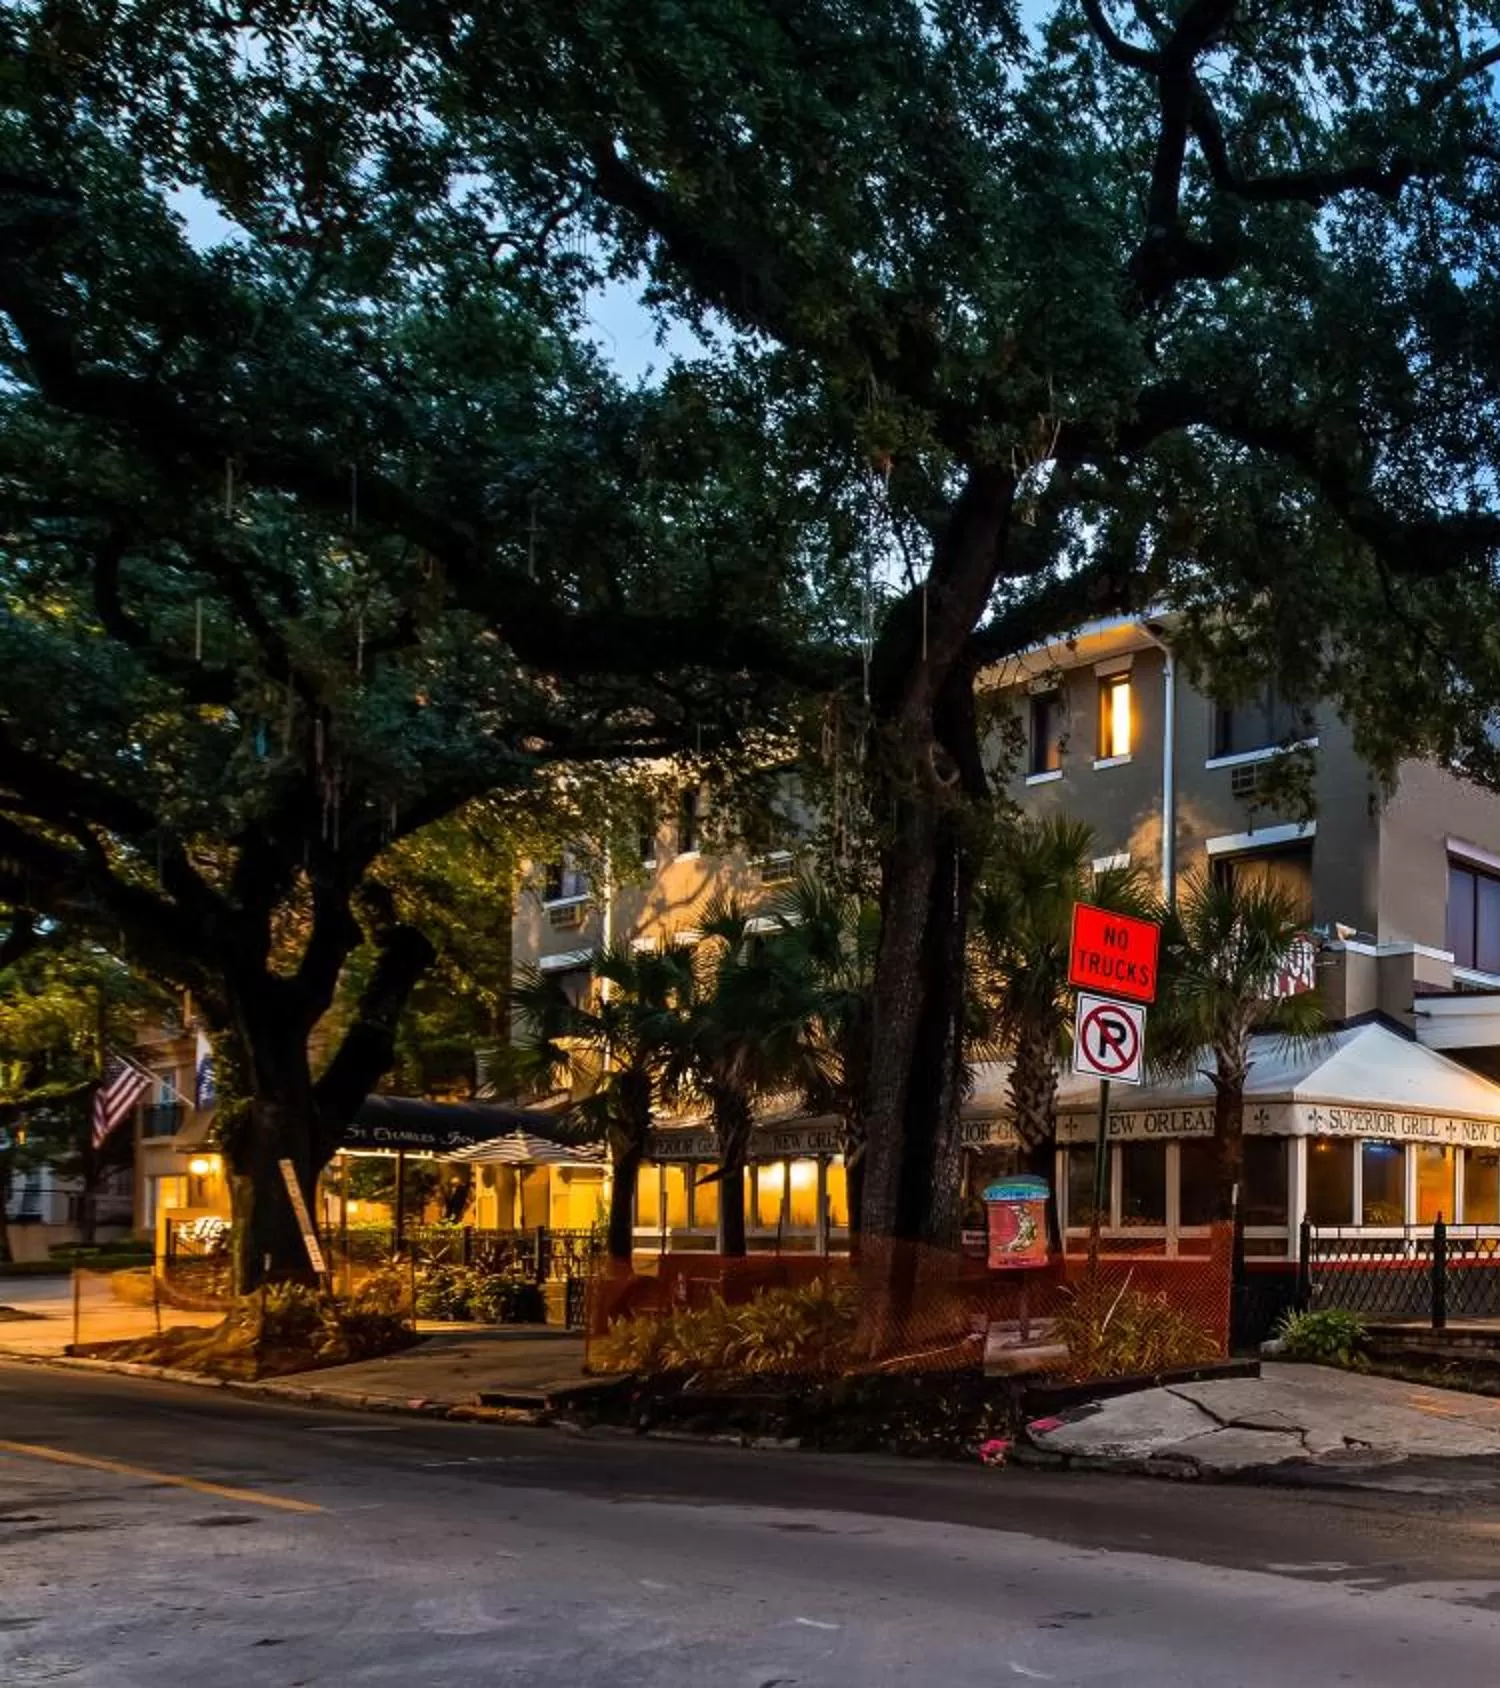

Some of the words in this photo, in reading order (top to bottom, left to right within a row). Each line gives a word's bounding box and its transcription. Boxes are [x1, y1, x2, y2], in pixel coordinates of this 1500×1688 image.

[1104, 926, 1129, 952] NO
[1079, 950, 1150, 987] TRUCKS
[1108, 1113, 1137, 1135] EW
[1144, 1109, 1217, 1133] ORLEAN
[1329, 1109, 1397, 1135] SUPERIOR
[1401, 1116, 1440, 1137] GRILL
[1462, 1121, 1489, 1141] NEW
